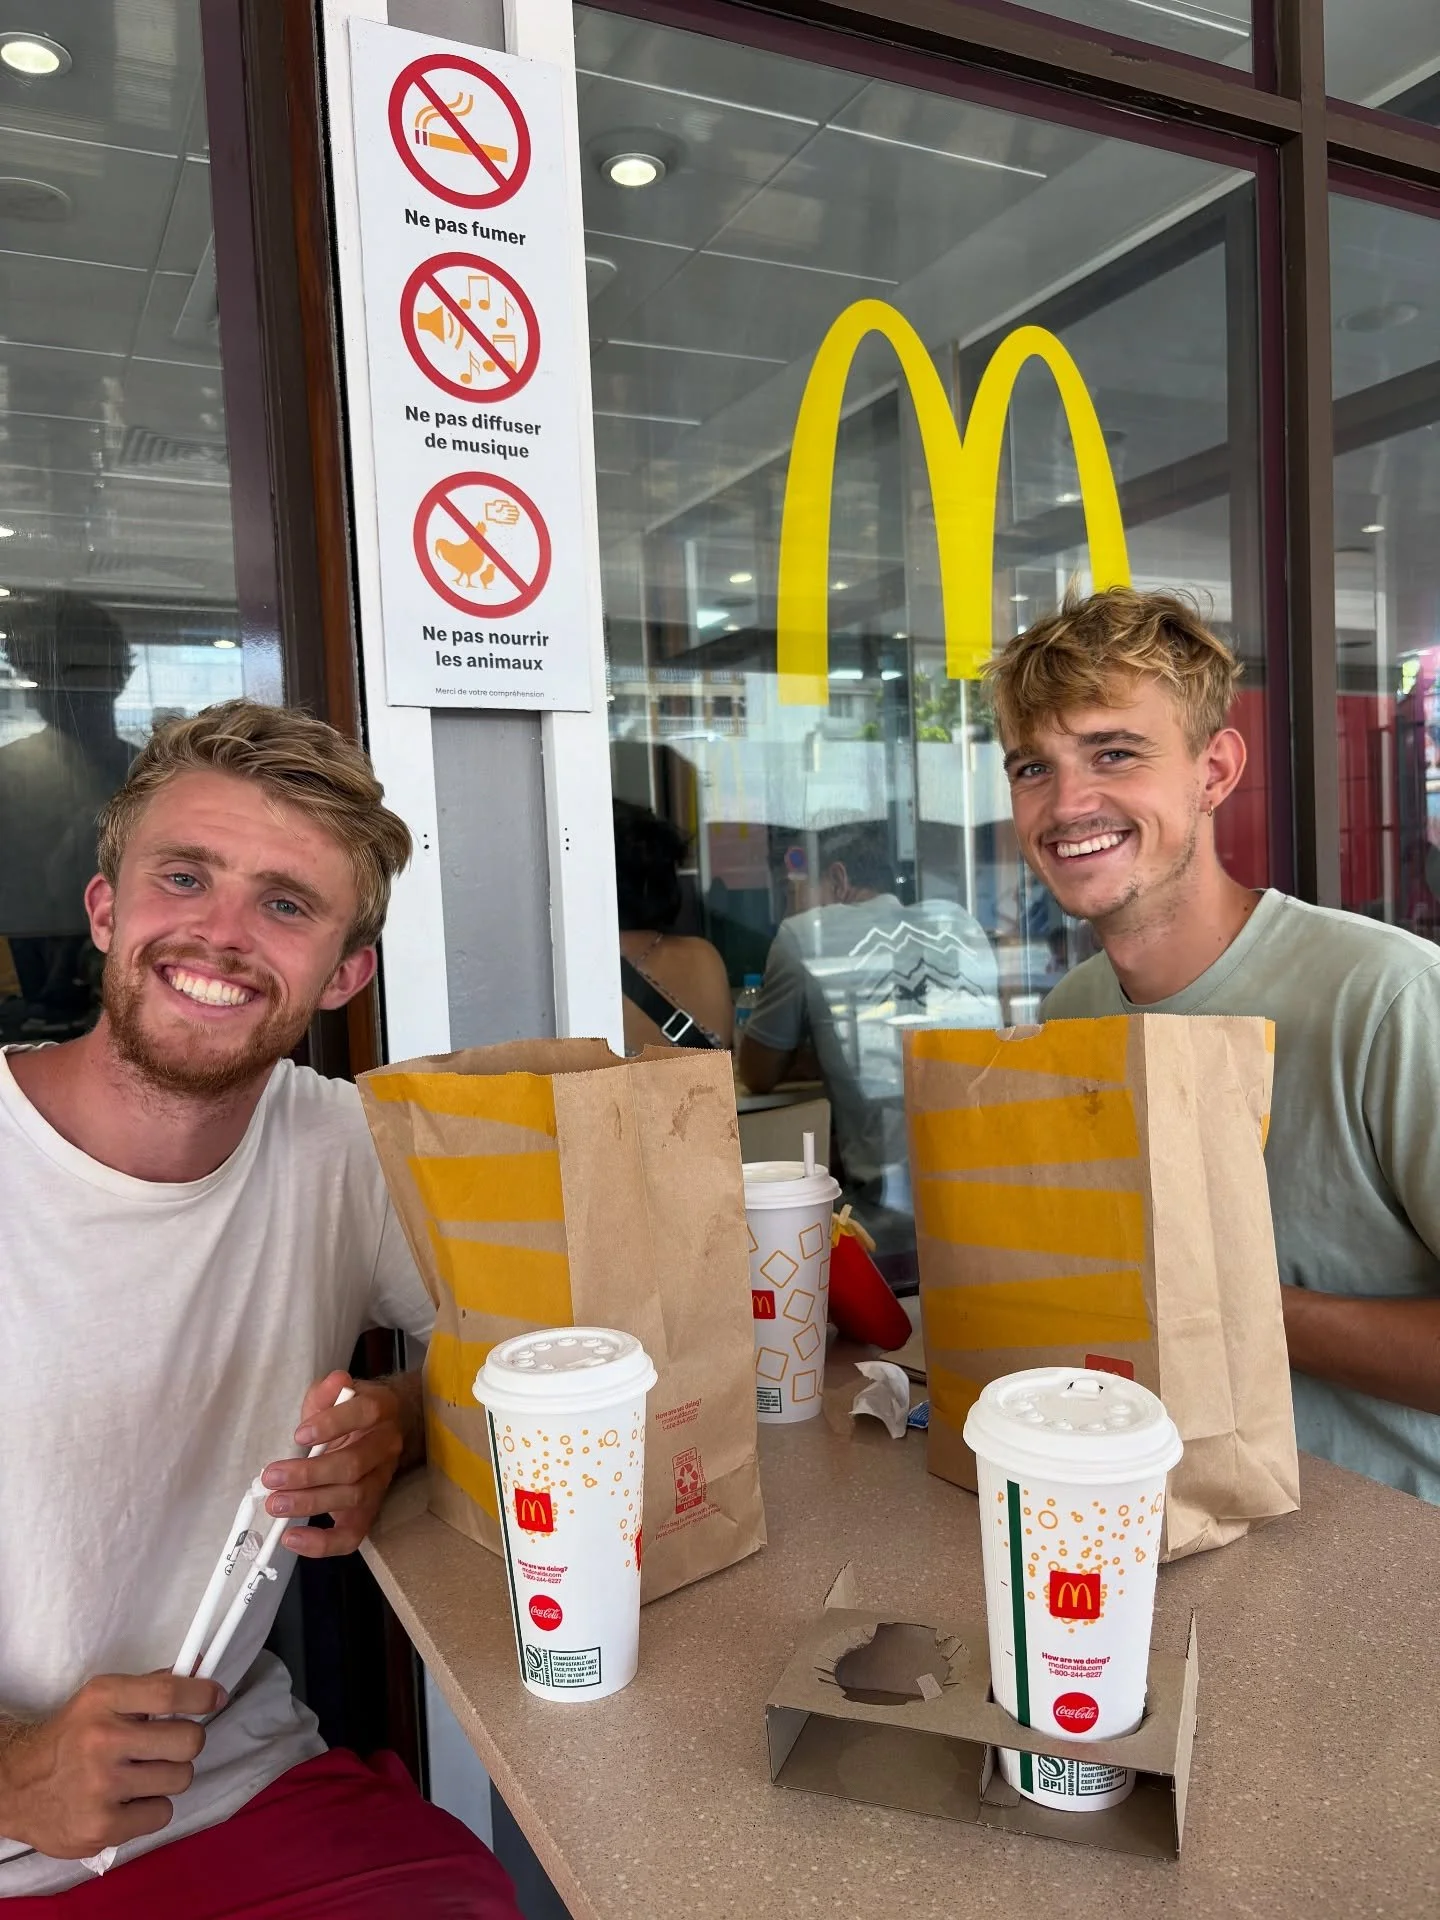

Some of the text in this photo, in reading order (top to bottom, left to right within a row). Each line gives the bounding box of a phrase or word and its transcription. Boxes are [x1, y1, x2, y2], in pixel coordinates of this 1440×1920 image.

[405, 208, 526, 245] Ne pas fumer
[405, 405, 541, 435] Ne pas diffuser
[424, 433, 529, 460] de musique
[422, 625, 549, 646] Ne pas nourrir
[435, 650, 544, 671] les animaux
[435, 687, 456, 695] Merci
[546, 1565, 568, 1573] doing?
[530, 1605, 561, 1620] Coca-Cola
[1041, 1651, 1060, 1661] How
[1060, 1656, 1073, 1664] are
[1085, 1656, 1111, 1665] doing?
[1048, 1661, 1103, 1671] mcdonalds.com
[1049, 1667, 1103, 1678] 1-800-244-6227
[1055, 1705, 1097, 1719] Coca-Cola
[1042, 1778, 1062, 1791] BPI
